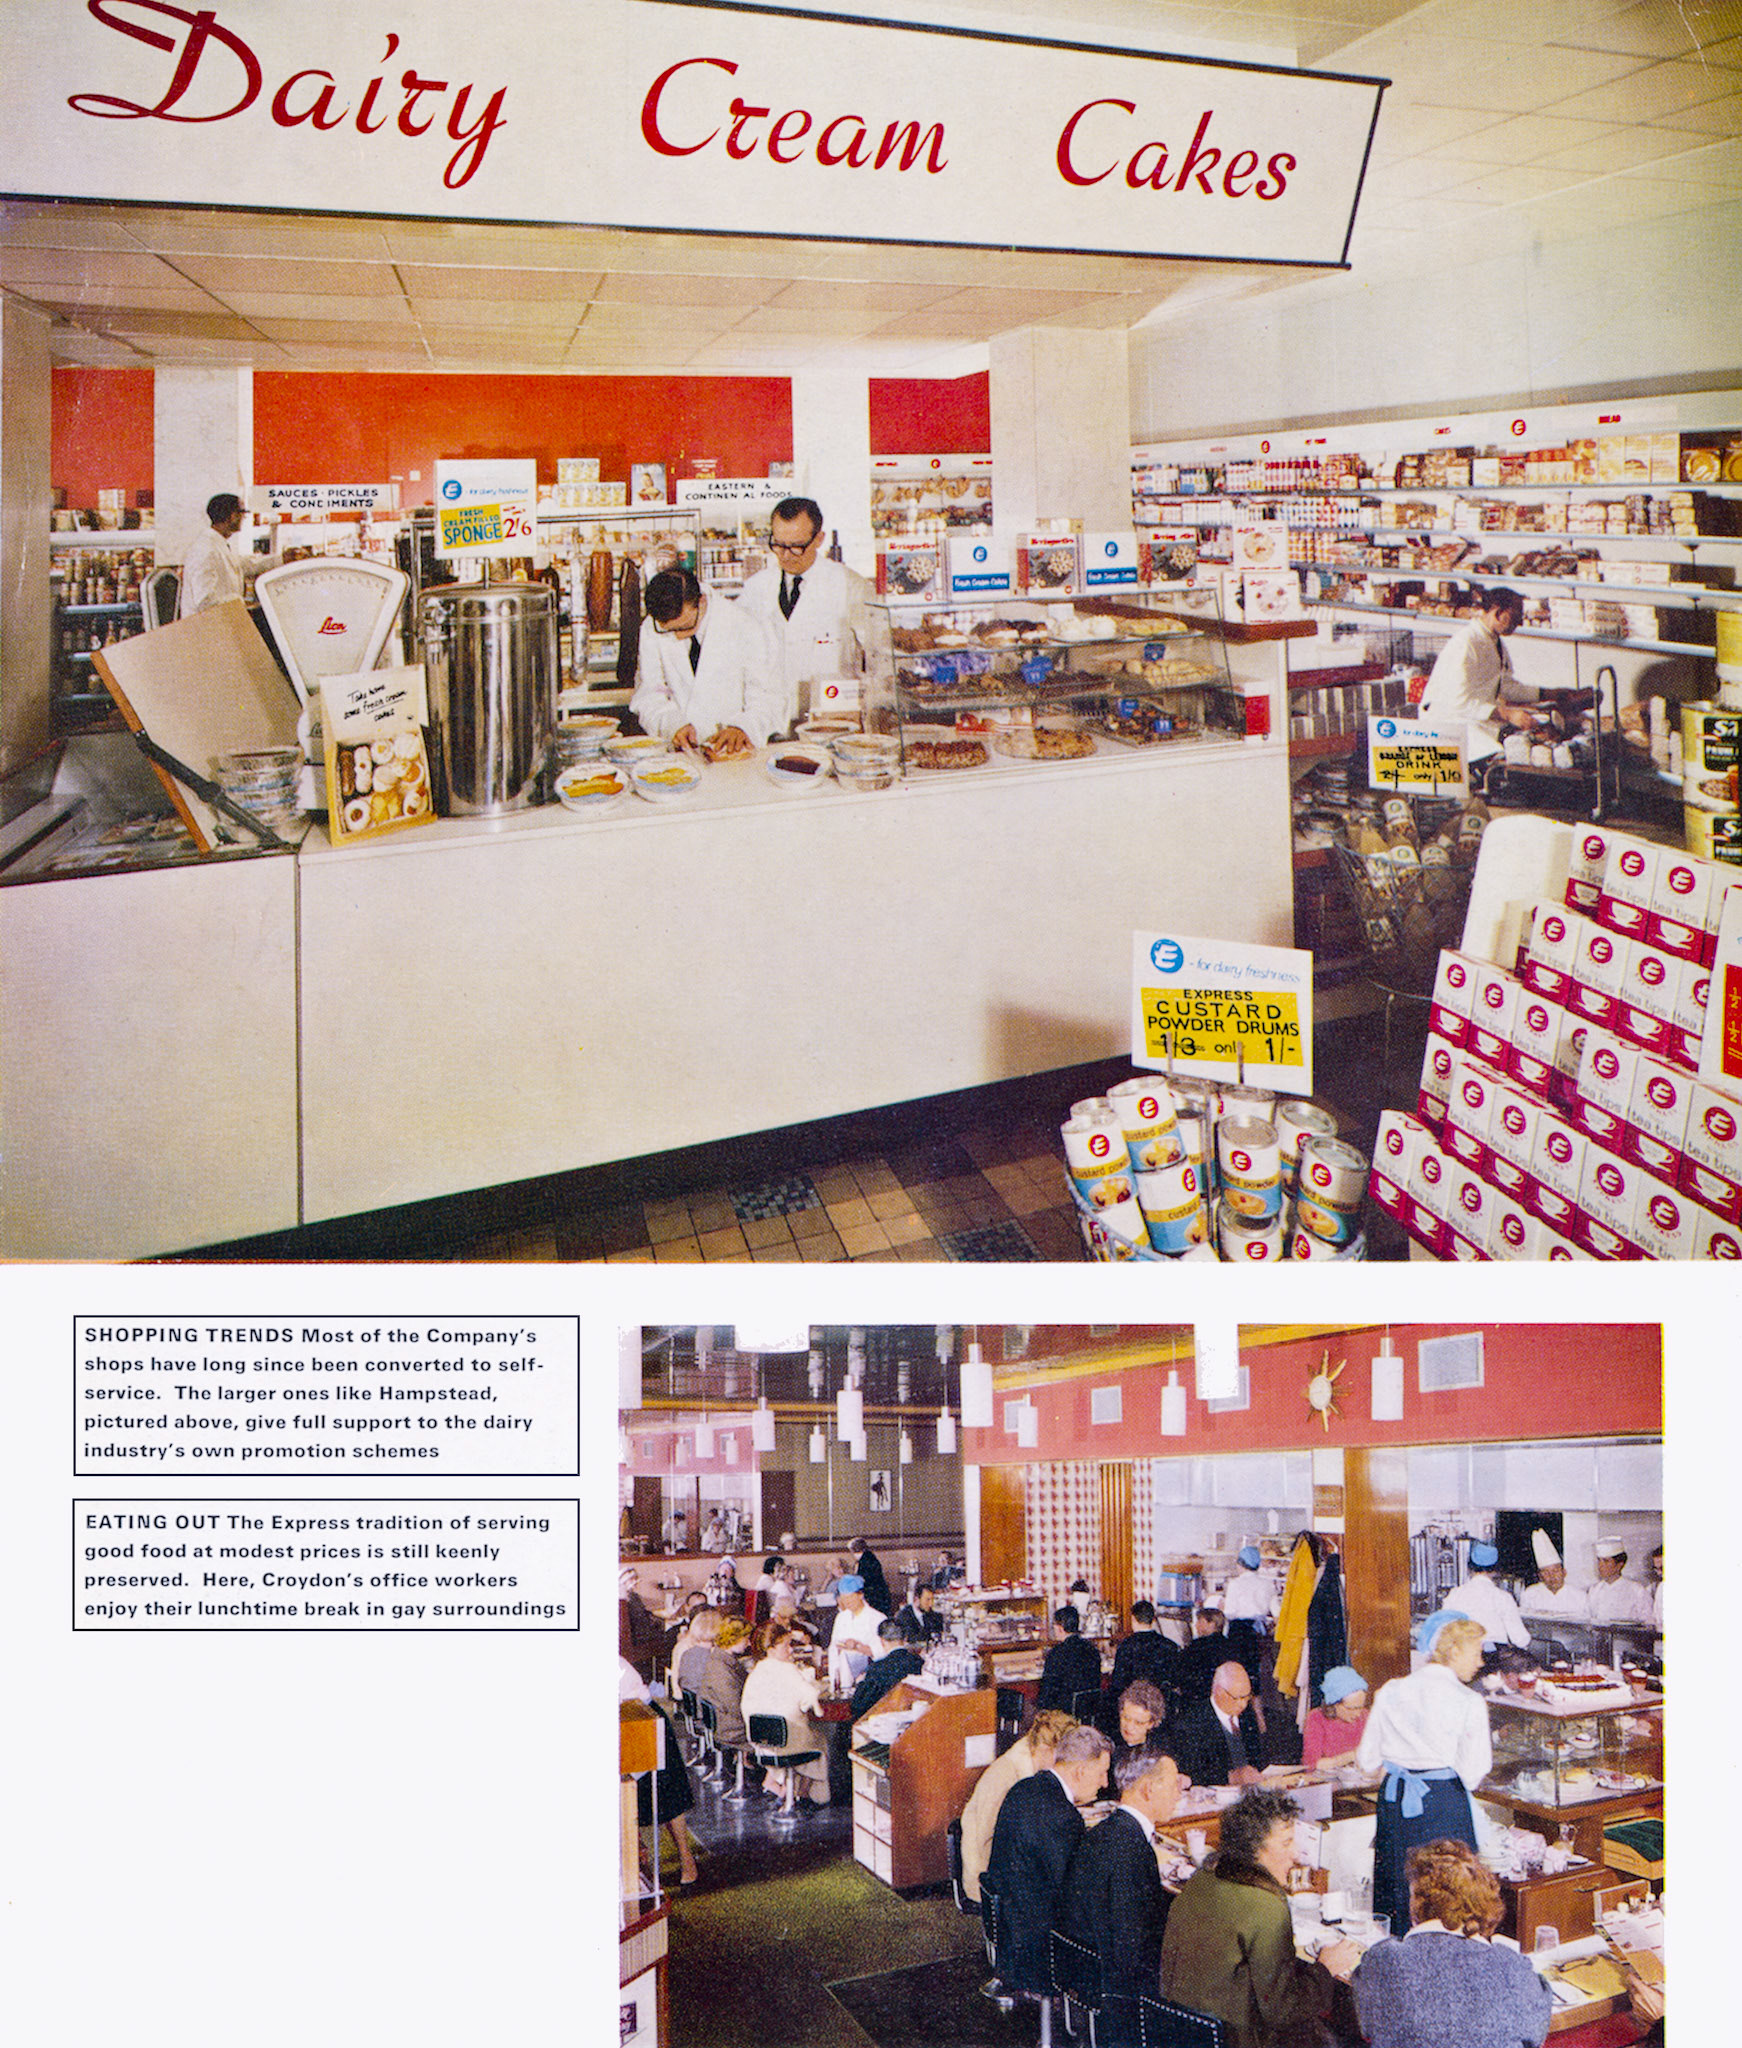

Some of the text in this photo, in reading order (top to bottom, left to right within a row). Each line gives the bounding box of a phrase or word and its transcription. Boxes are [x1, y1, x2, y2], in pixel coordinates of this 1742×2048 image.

[67, 0, 1296, 200] Dairy Cream Cakes
[268, 489, 378, 498] SAUCES PICKLES
[685, 492, 755, 500] CONTINENAL
[271, 500, 281, 508] &
[444, 522, 502, 545] SPONGE
[1396, 761, 1441, 769] DRINK
[1183, 988, 1253, 1001] EXPRESS
[1156, 1000, 1281, 1019] CUSTARD
[1148, 1016, 1299, 1036] POWDER DRUMS
[1214, 1041, 1245, 1054] onl
[1631, 1110, 1680, 1145] tea tips
[1688, 1141, 1741, 1181] tea tips
[1582, 1196, 1628, 1234] tea tips
[1634, 1229, 1654, 1251] tea
[85, 1327, 537, 1346] SHOPPING TRENDS Most of the Company’s
[84, 1356, 544, 1375] shops have long since been converted to self-
[84, 1385, 497, 1404] service. The larger ones like Hampstead,
[84, 1413, 533, 1433] pictured above, give full support to the dairy
[84, 1442, 439, 1461] industry’s own promotion schemes
[86, 1514, 550, 1533] EATING OUT The Express tradition of serving
[84, 1543, 500, 1562] good food at modest prices is still keenly
[84, 1572, 518, 1590] preserved. Here, Croydon’s office workers
[84, 1601, 566, 1619] enjoy their lunchtime break in gay surroundings
